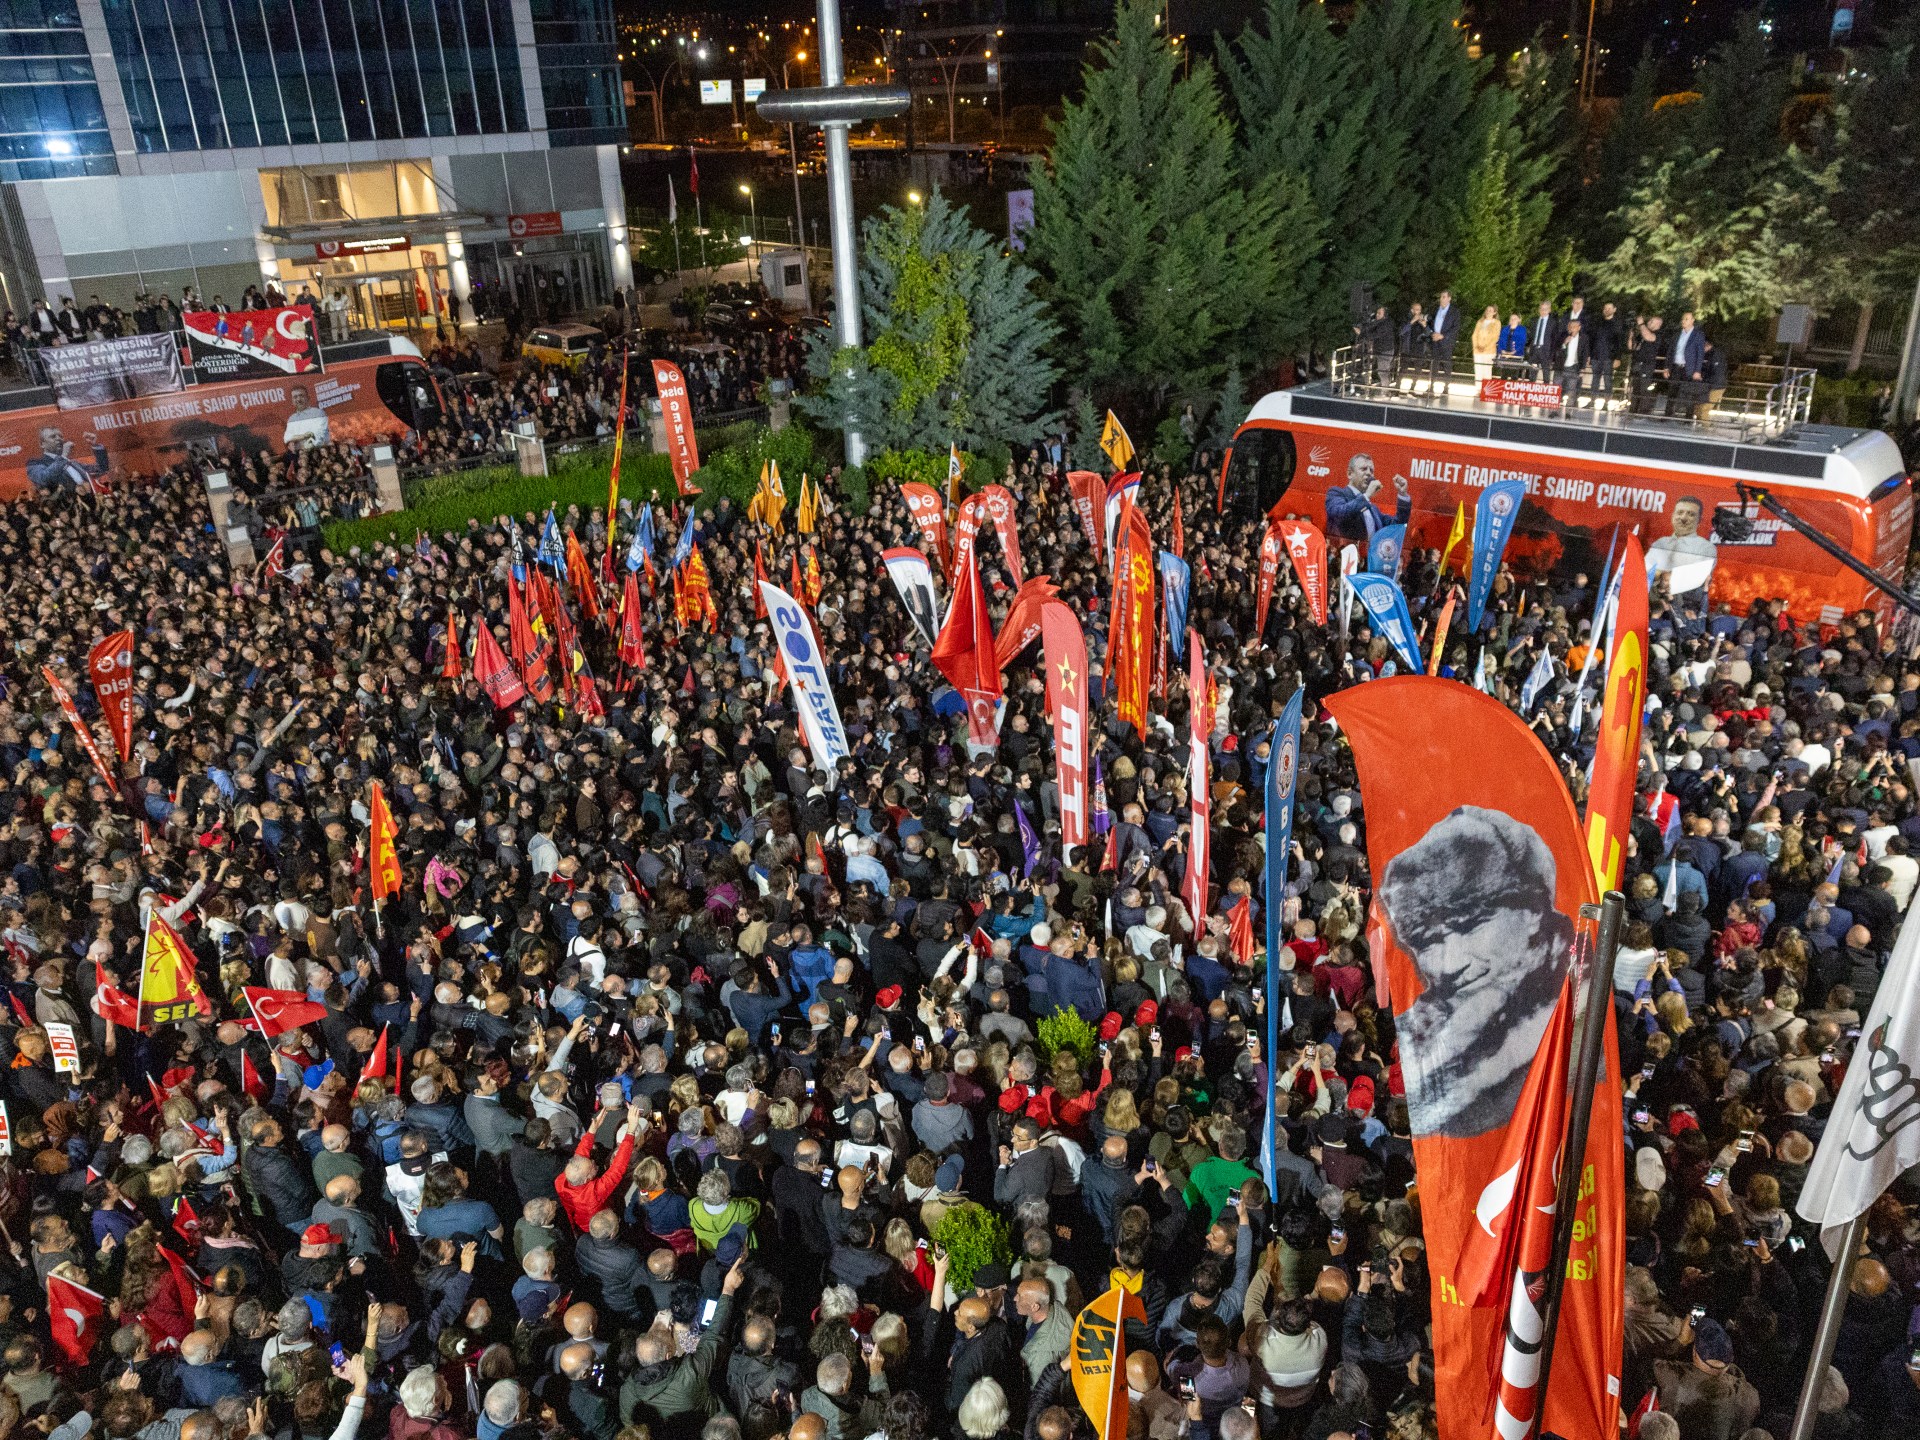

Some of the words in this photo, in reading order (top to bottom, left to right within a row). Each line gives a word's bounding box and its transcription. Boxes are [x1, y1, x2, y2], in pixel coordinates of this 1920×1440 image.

[49, 348, 88, 361] YARGI
[90, 337, 152, 354] DARBESİNİ
[50, 358, 90, 373] KABUL
[207, 365, 239, 374] HEDEFE
[1504, 381, 1560, 395] CUMHURİYET
[1502, 391, 1526, 401] HALK
[1527, 394, 1559, 404] PARTİSİ
[93, 410, 138, 431] MİLLET
[141, 400, 202, 424] İRADESİNE
[203, 395, 238, 413] SAHİP
[240, 387, 286, 410] ÇIKIYOR
[1307, 465, 1330, 477] CHP
[1410, 458, 1462, 484] MİLLET
[1544, 476, 1595, 502] SAHİP
[1596, 483, 1667, 513] ÇIKIYOR
